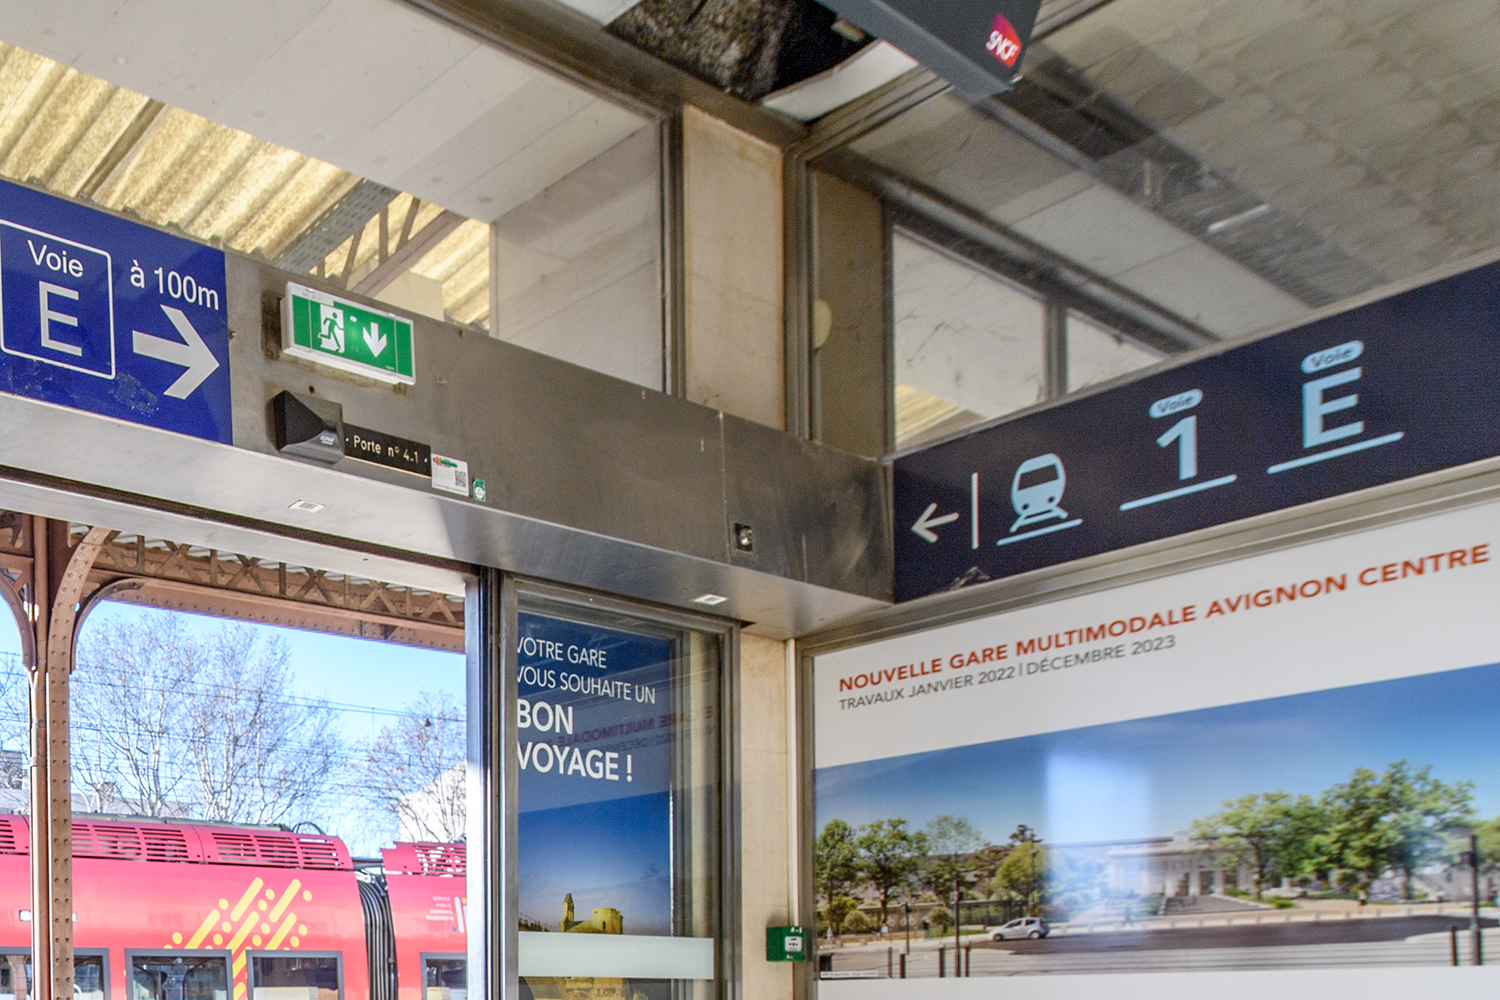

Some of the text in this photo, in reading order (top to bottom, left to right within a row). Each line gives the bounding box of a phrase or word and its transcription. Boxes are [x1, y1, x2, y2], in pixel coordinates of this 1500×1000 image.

[985, 30, 1019, 61] SNCF
[27, 239, 84, 279] Voie
[130, 259, 220, 311] à 100m
[38, 280, 83, 357] E
[1309, 345, 1355, 371] Voie
[1157, 394, 1194, 415] Voie
[1302, 366, 1364, 449] E
[353, 434, 382, 455] Porte
[387, 446, 400, 458] n°
[1156, 414, 1198, 481] 1
[839, 542, 1492, 693] NOUVELLE GARE MULTIMODALE AVIGNON CENTRE
[567, 644, 607, 669] GARE
[839, 686, 905, 711] TRAVAUX
[907, 673, 973, 700] JANVIER
[977, 665, 1016, 683] 2022
[1026, 642, 1127, 675] DÉCEMBRE
[1131, 635, 1176, 656] 2023
[559, 672, 632, 700] SOUHAITE
[635, 684, 656, 704] UN
[517, 698, 574, 735] BON
[517, 741, 633, 783] VOYAGE !
